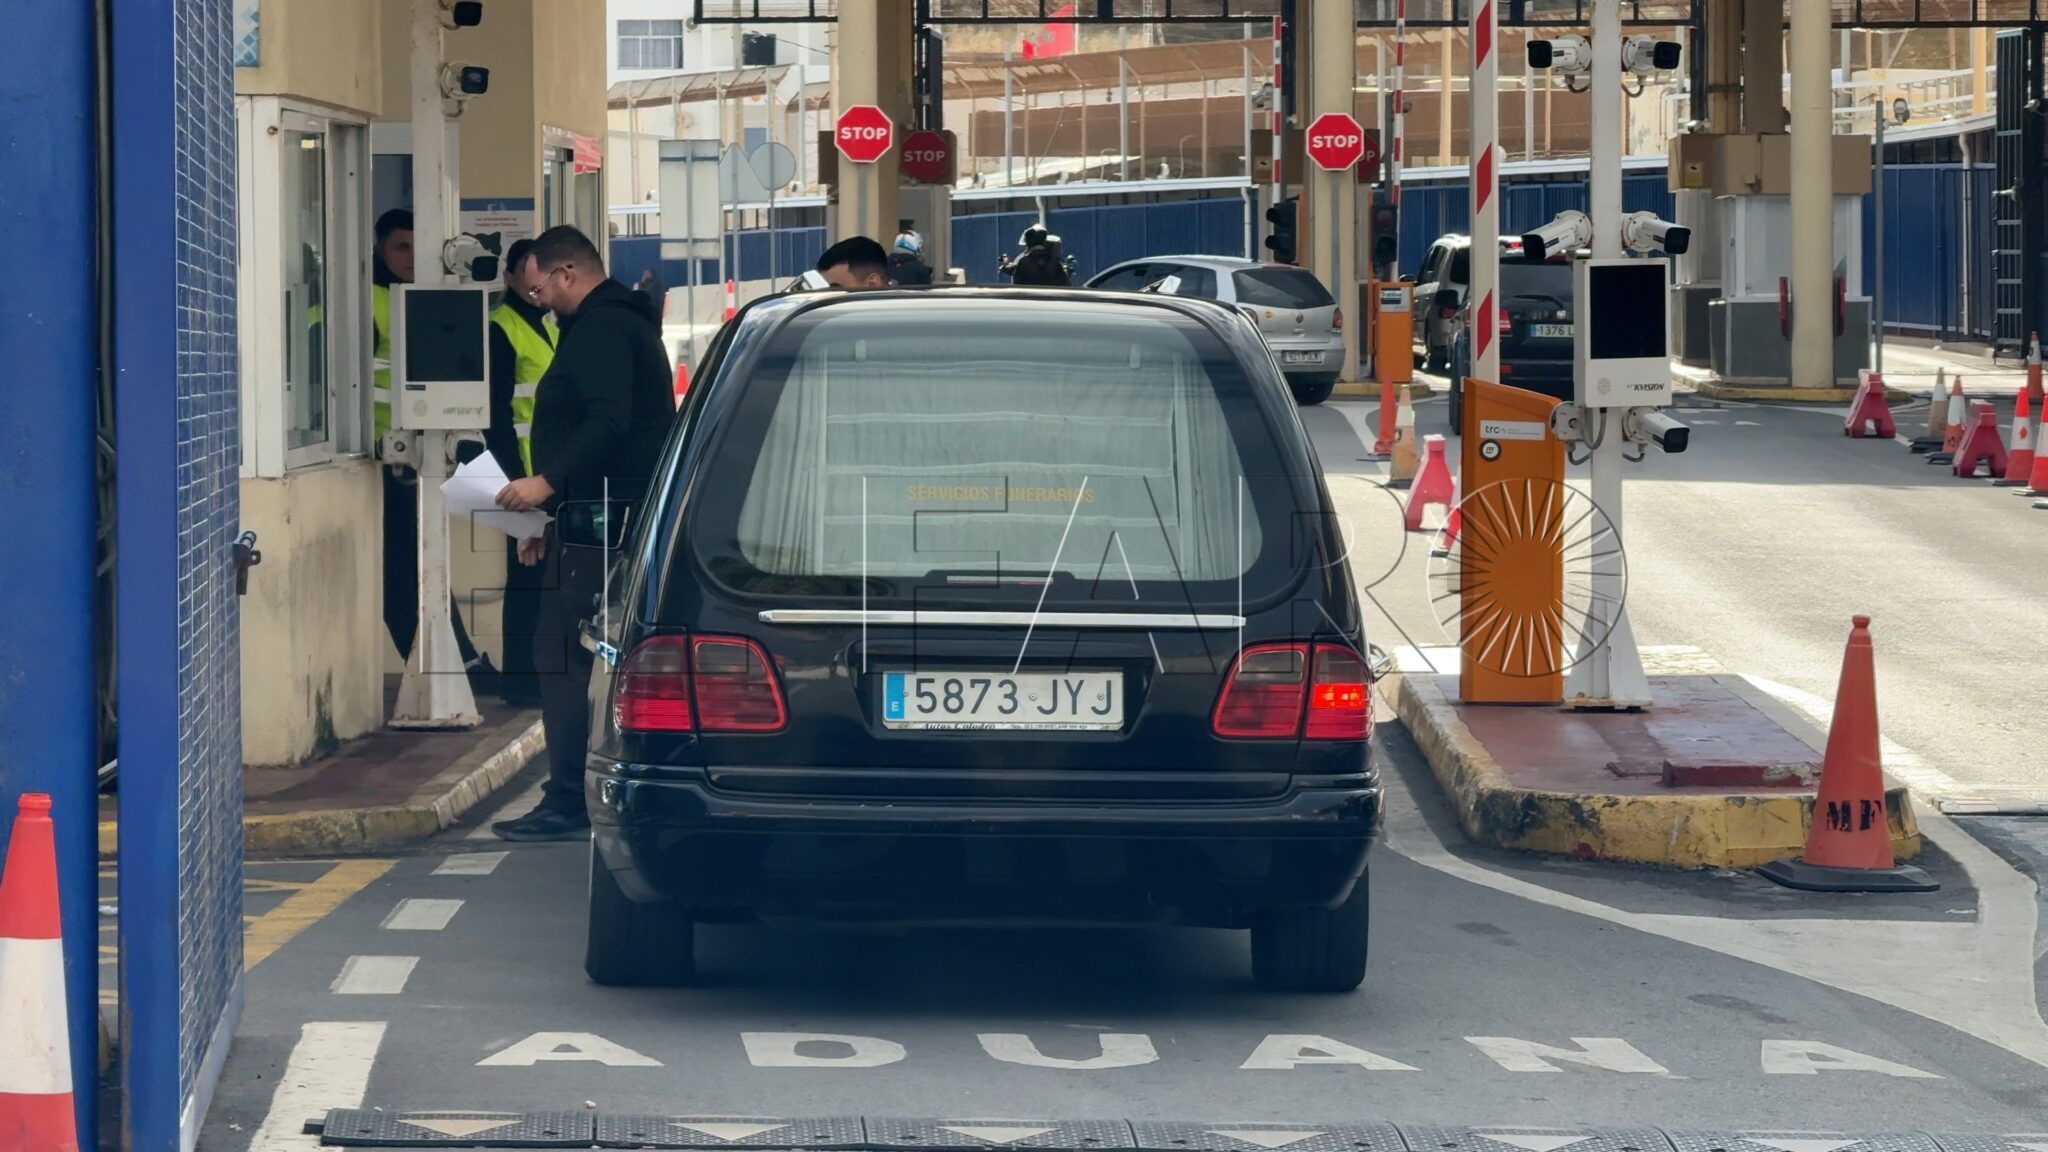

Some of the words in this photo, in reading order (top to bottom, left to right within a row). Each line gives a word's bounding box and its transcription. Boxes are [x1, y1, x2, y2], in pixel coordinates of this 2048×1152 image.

[841, 126, 888, 140] STOP
[1312, 134, 1359, 149] STOP
[904, 150, 946, 162] STOP
[1627, 383, 1664, 392] KVISION
[907, 485, 990, 501] SERVICIOS
[995, 487, 1095, 503] FUNERARIOS
[915, 678, 1019, 715] 5873
[1036, 679, 1112, 716] JYJ
[474, 1031, 1947, 1080] ADUANA
